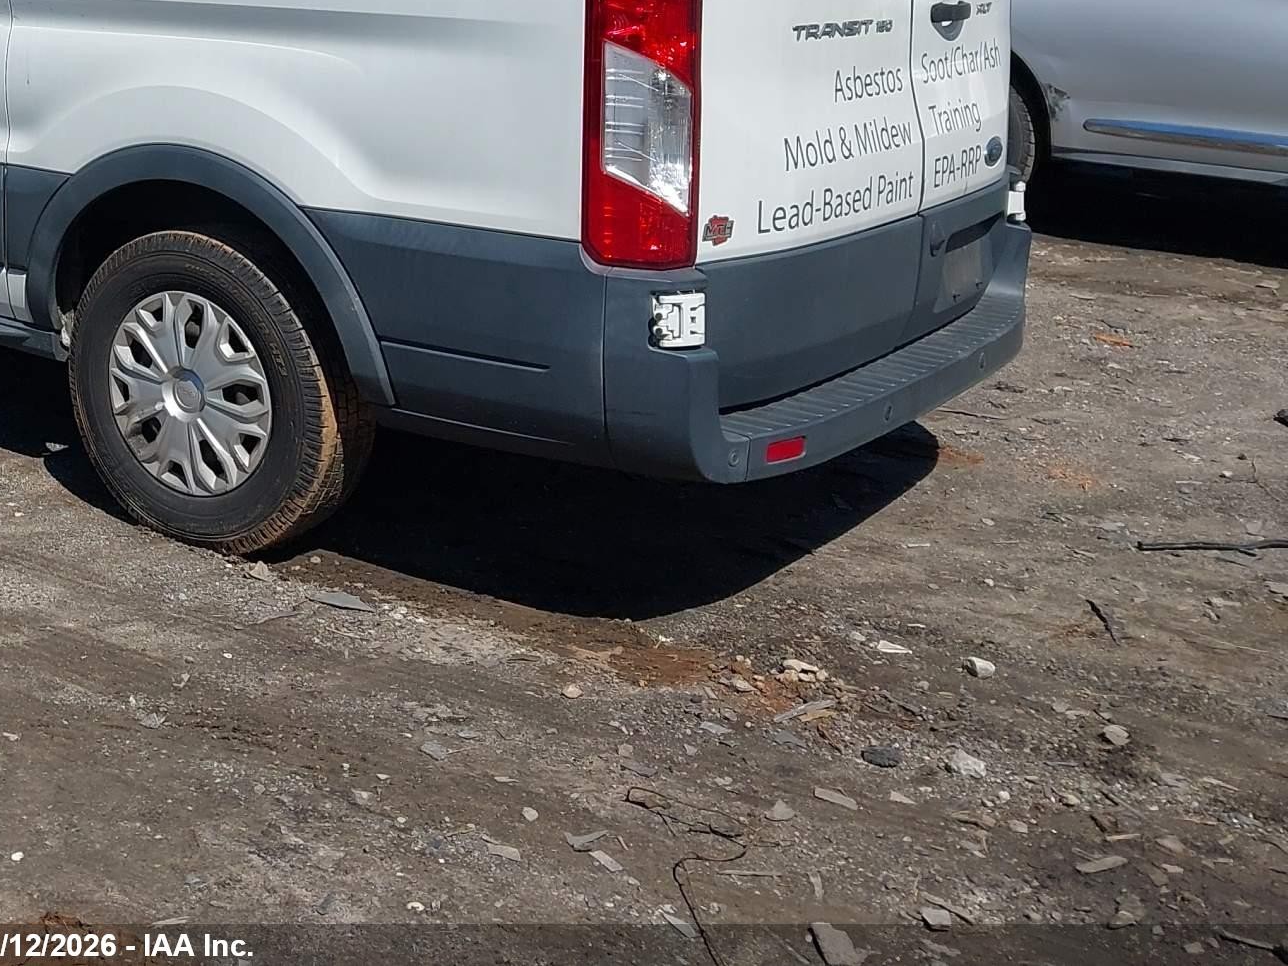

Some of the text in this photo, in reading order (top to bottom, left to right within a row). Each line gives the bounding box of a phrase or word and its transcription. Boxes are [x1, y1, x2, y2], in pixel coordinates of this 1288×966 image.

[792, 19, 874, 42] TRANSIT
[921, 38, 1002, 84] Soot/Char/Ash
[834, 66, 904, 103] Asbestos
[928, 99, 982, 135] Training
[784, 117, 912, 172] Mold & Mildew
[934, 145, 982, 189] EPA-RRP
[757, 171, 914, 234] Lead-Based Paint
